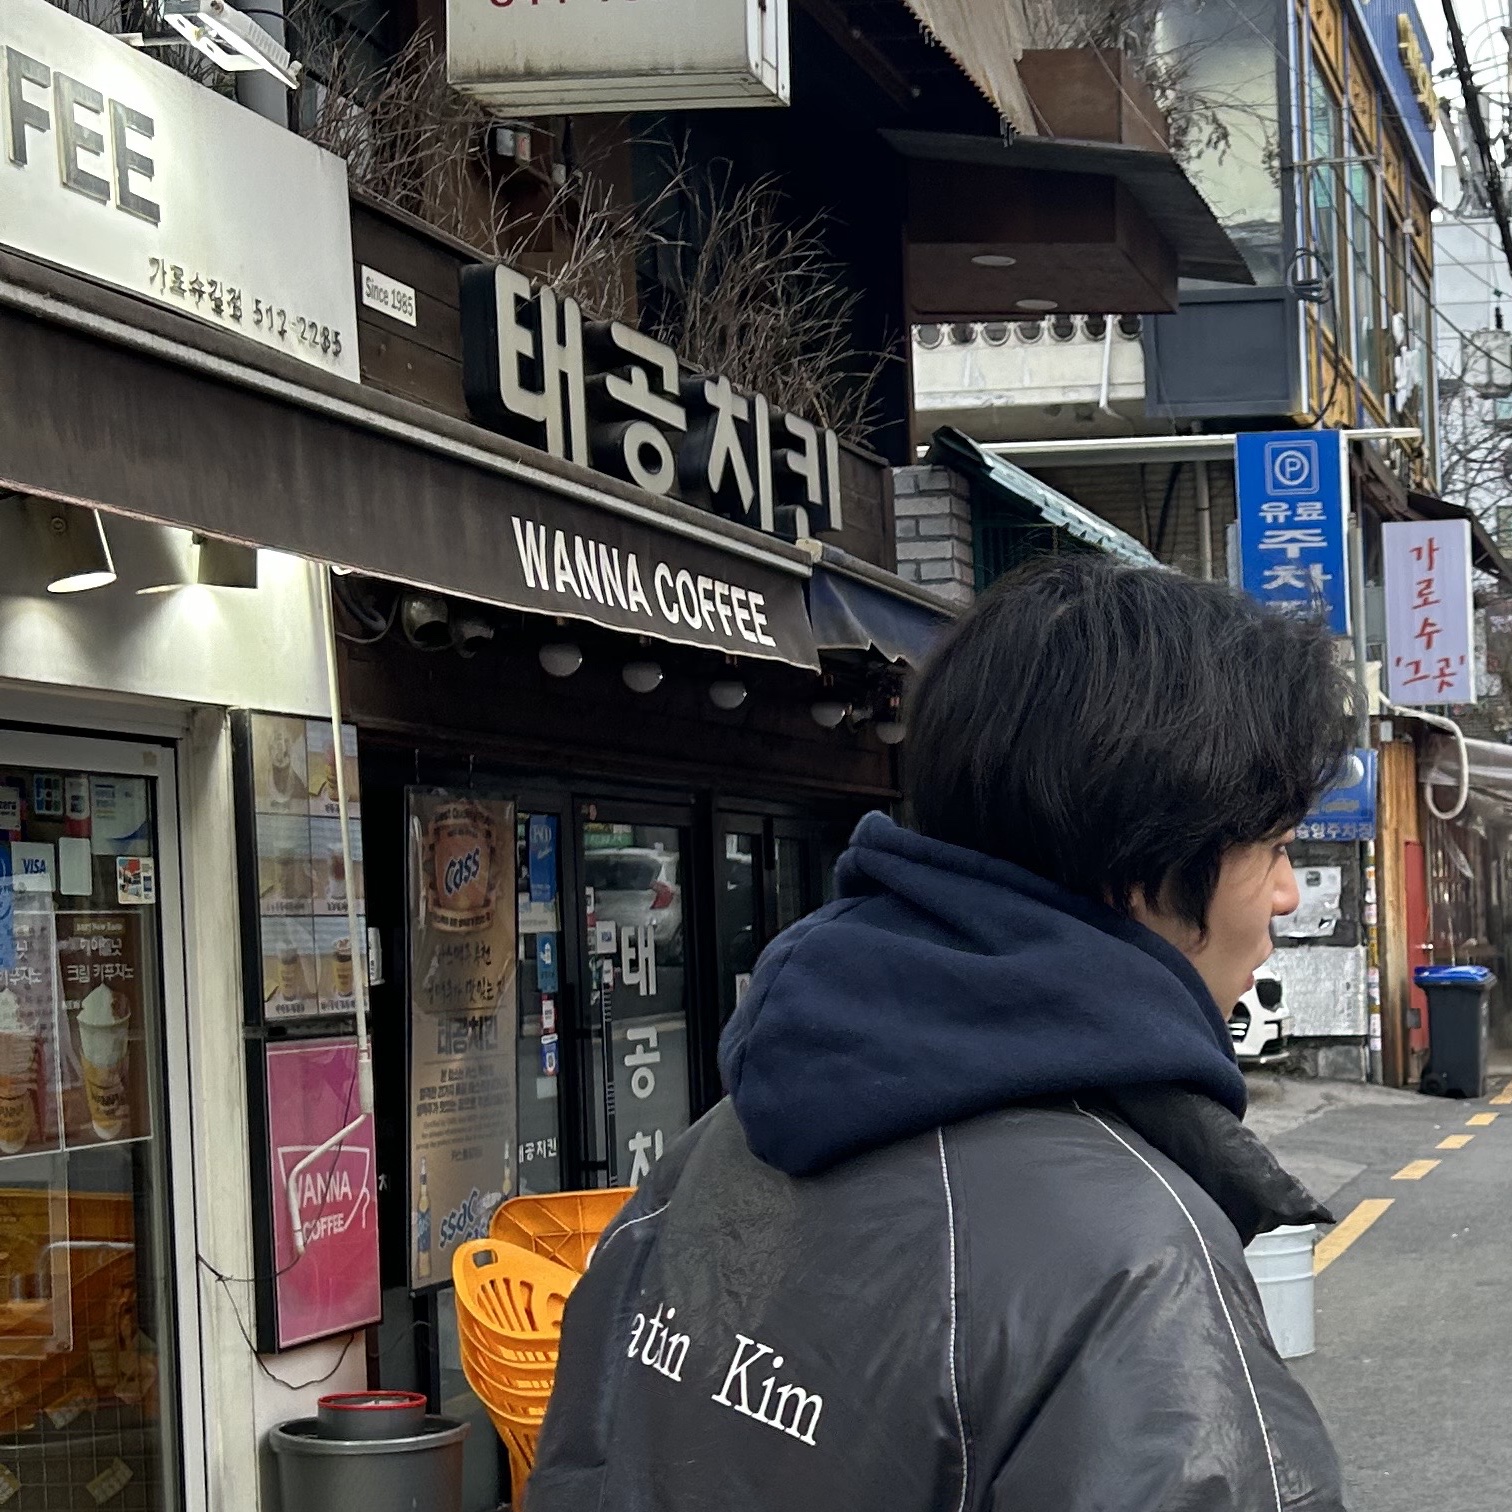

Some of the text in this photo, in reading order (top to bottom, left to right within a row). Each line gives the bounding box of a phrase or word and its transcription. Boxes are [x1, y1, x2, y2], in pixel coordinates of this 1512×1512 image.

[2, 45, 161, 225] FEE
[148, 256, 243, 324] 가로수길점
[365, 275, 414, 318] Since 1985
[495, 263, 843, 540] 태공치킨
[1258, 501, 1328, 524] 유료
[511, 515, 777, 648] WANNA COFFEE
[1257, 528, 1334, 616] 주차
[1408, 536, 1442, 651] 가로수
[23, 857, 47, 875] VISA
[302, 1212, 345, 1244] COFFEE
[711, 1333, 823, 1447] Kim
